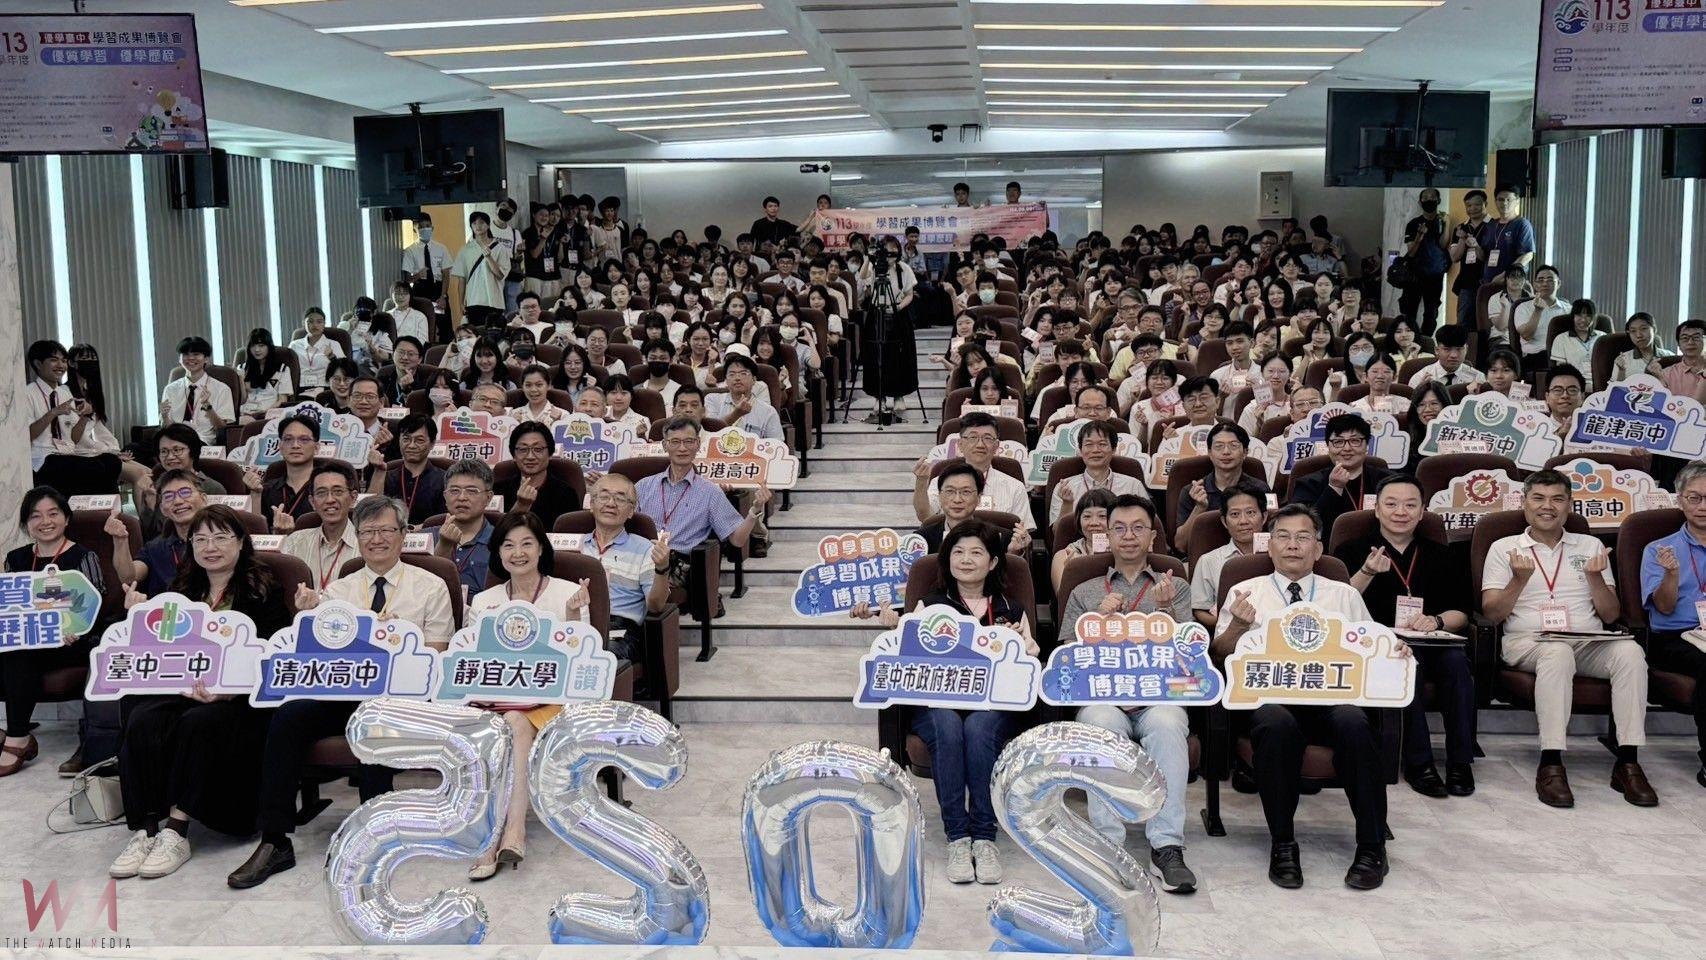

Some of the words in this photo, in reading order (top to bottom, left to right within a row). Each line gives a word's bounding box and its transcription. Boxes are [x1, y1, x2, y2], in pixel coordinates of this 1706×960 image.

[1594, 0, 1631, 20] 113
[1437, 426, 1515, 454] 新社高中
[1585, 415, 1666, 443] 龍津高中
[697, 462, 760, 479] 中港高中
[818, 557, 900, 585] 學習成果
[831, 582, 892, 608] 博覽會
[1083, 619, 1168, 637] 優學臺中
[107, 651, 211, 680] 臺中二中
[1073, 645, 1175, 669] 學習成果
[273, 660, 379, 686] 清水高中
[454, 659, 558, 688] 靜宜大學
[575, 664, 600, 691] 讚
[873, 662, 988, 693] 臺中市政府教育局
[1088, 674, 1163, 698] 博覽會
[1245, 661, 1353, 690] 霧峰農工
